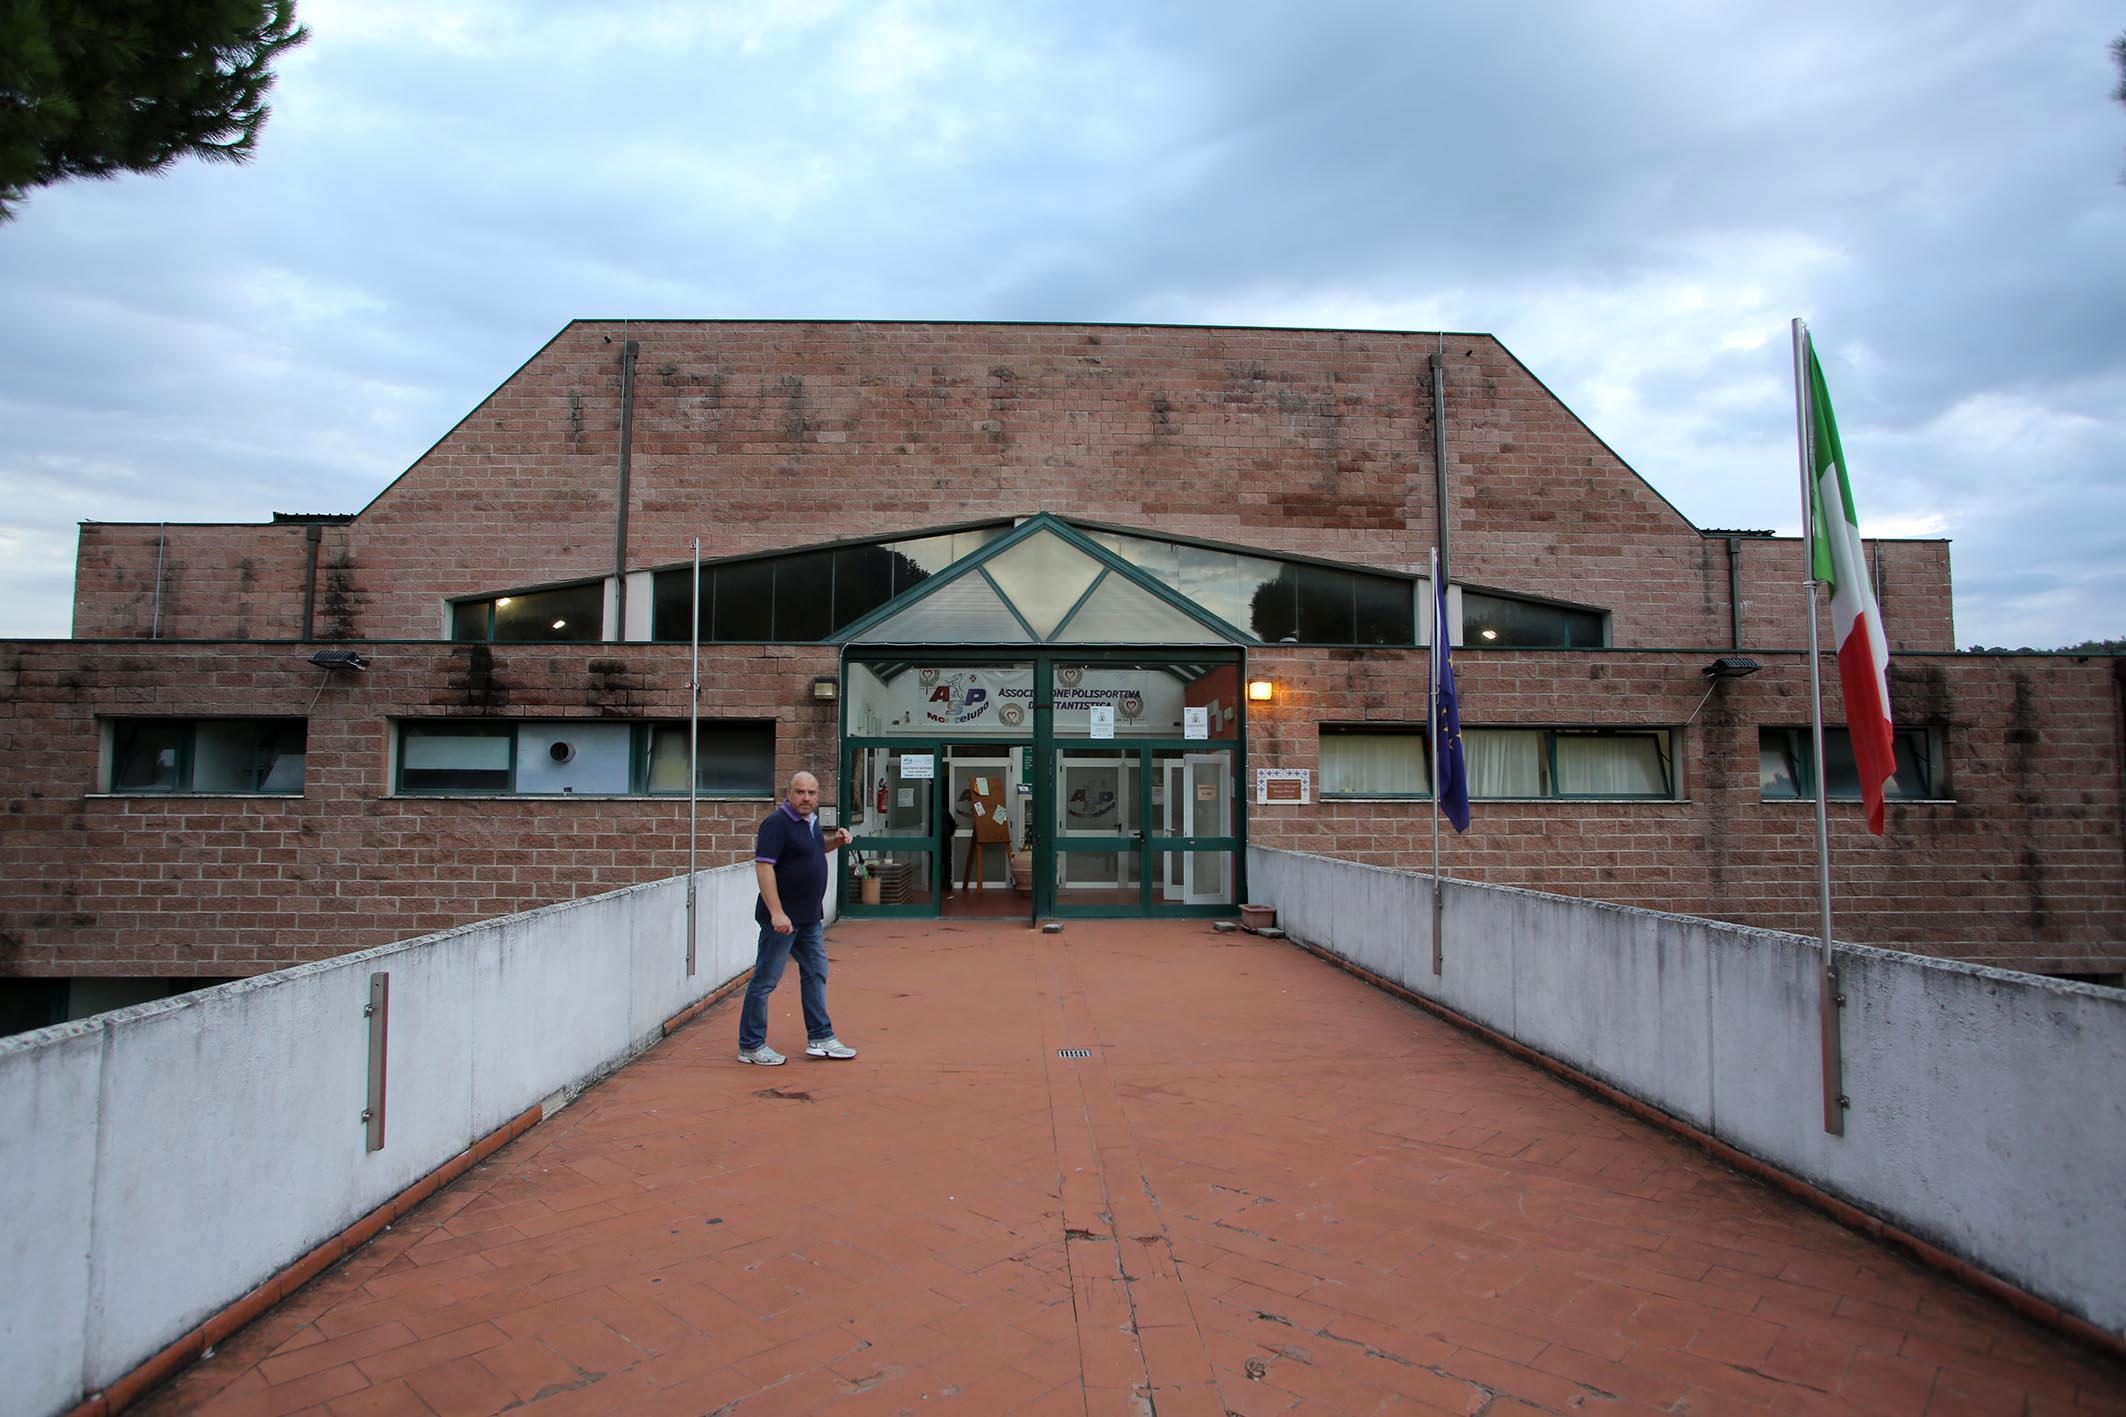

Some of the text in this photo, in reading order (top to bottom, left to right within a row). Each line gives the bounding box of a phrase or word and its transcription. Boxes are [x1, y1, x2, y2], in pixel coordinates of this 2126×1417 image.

[998, 688, 1141, 699] ASSOCINE POLISPORTIVA
[926, 701, 990, 723] Moelupo
